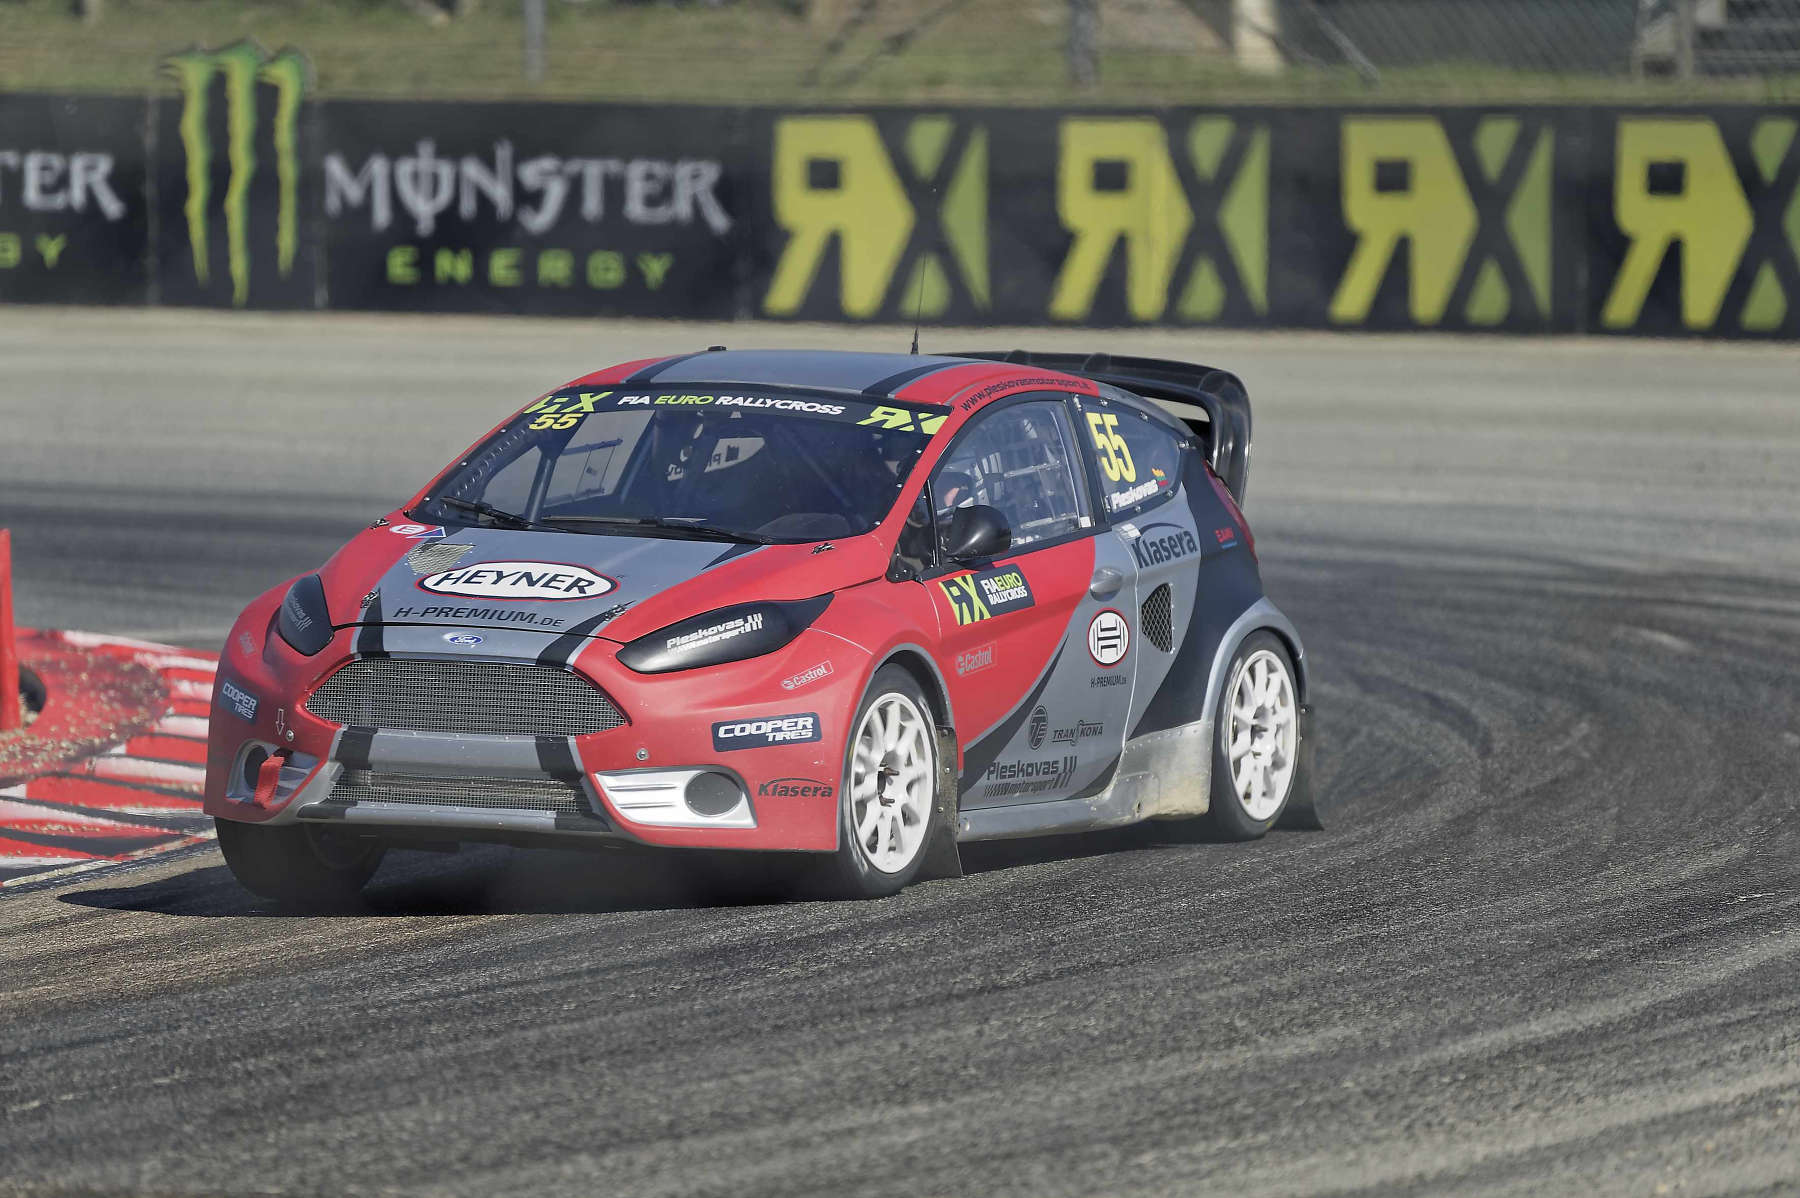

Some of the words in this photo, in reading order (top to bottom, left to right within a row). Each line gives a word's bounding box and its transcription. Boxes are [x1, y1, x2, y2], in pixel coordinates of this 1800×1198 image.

[324, 139, 732, 236] MONSTER
[386, 246, 673, 290] ENERGY
[617, 395, 650, 405] FIA
[654, 395, 714, 405] EURO
[715, 396, 846, 415] RALLYCROSS
[528, 413, 584, 430] 55
[1085, 411, 1136, 483] 55
[1131, 530, 1198, 569] Klasera
[433, 569, 596, 595] HEYNER
[987, 586, 1028, 606] RALLYCROSS
[393, 606, 565, 628] H-PREMIUM.DE
[666, 618, 744, 649] Pleskovas
[964, 646, 993, 672] Castrol
[793, 664, 828, 687] Castrol
[222, 682, 257, 711] COOPER
[234, 702, 255, 719] TIRES
[718, 717, 814, 738] COOPER
[766, 729, 813, 742] TIRES
[987, 760, 1060, 781] Pleskovas
[758, 783, 833, 798] Klasera
